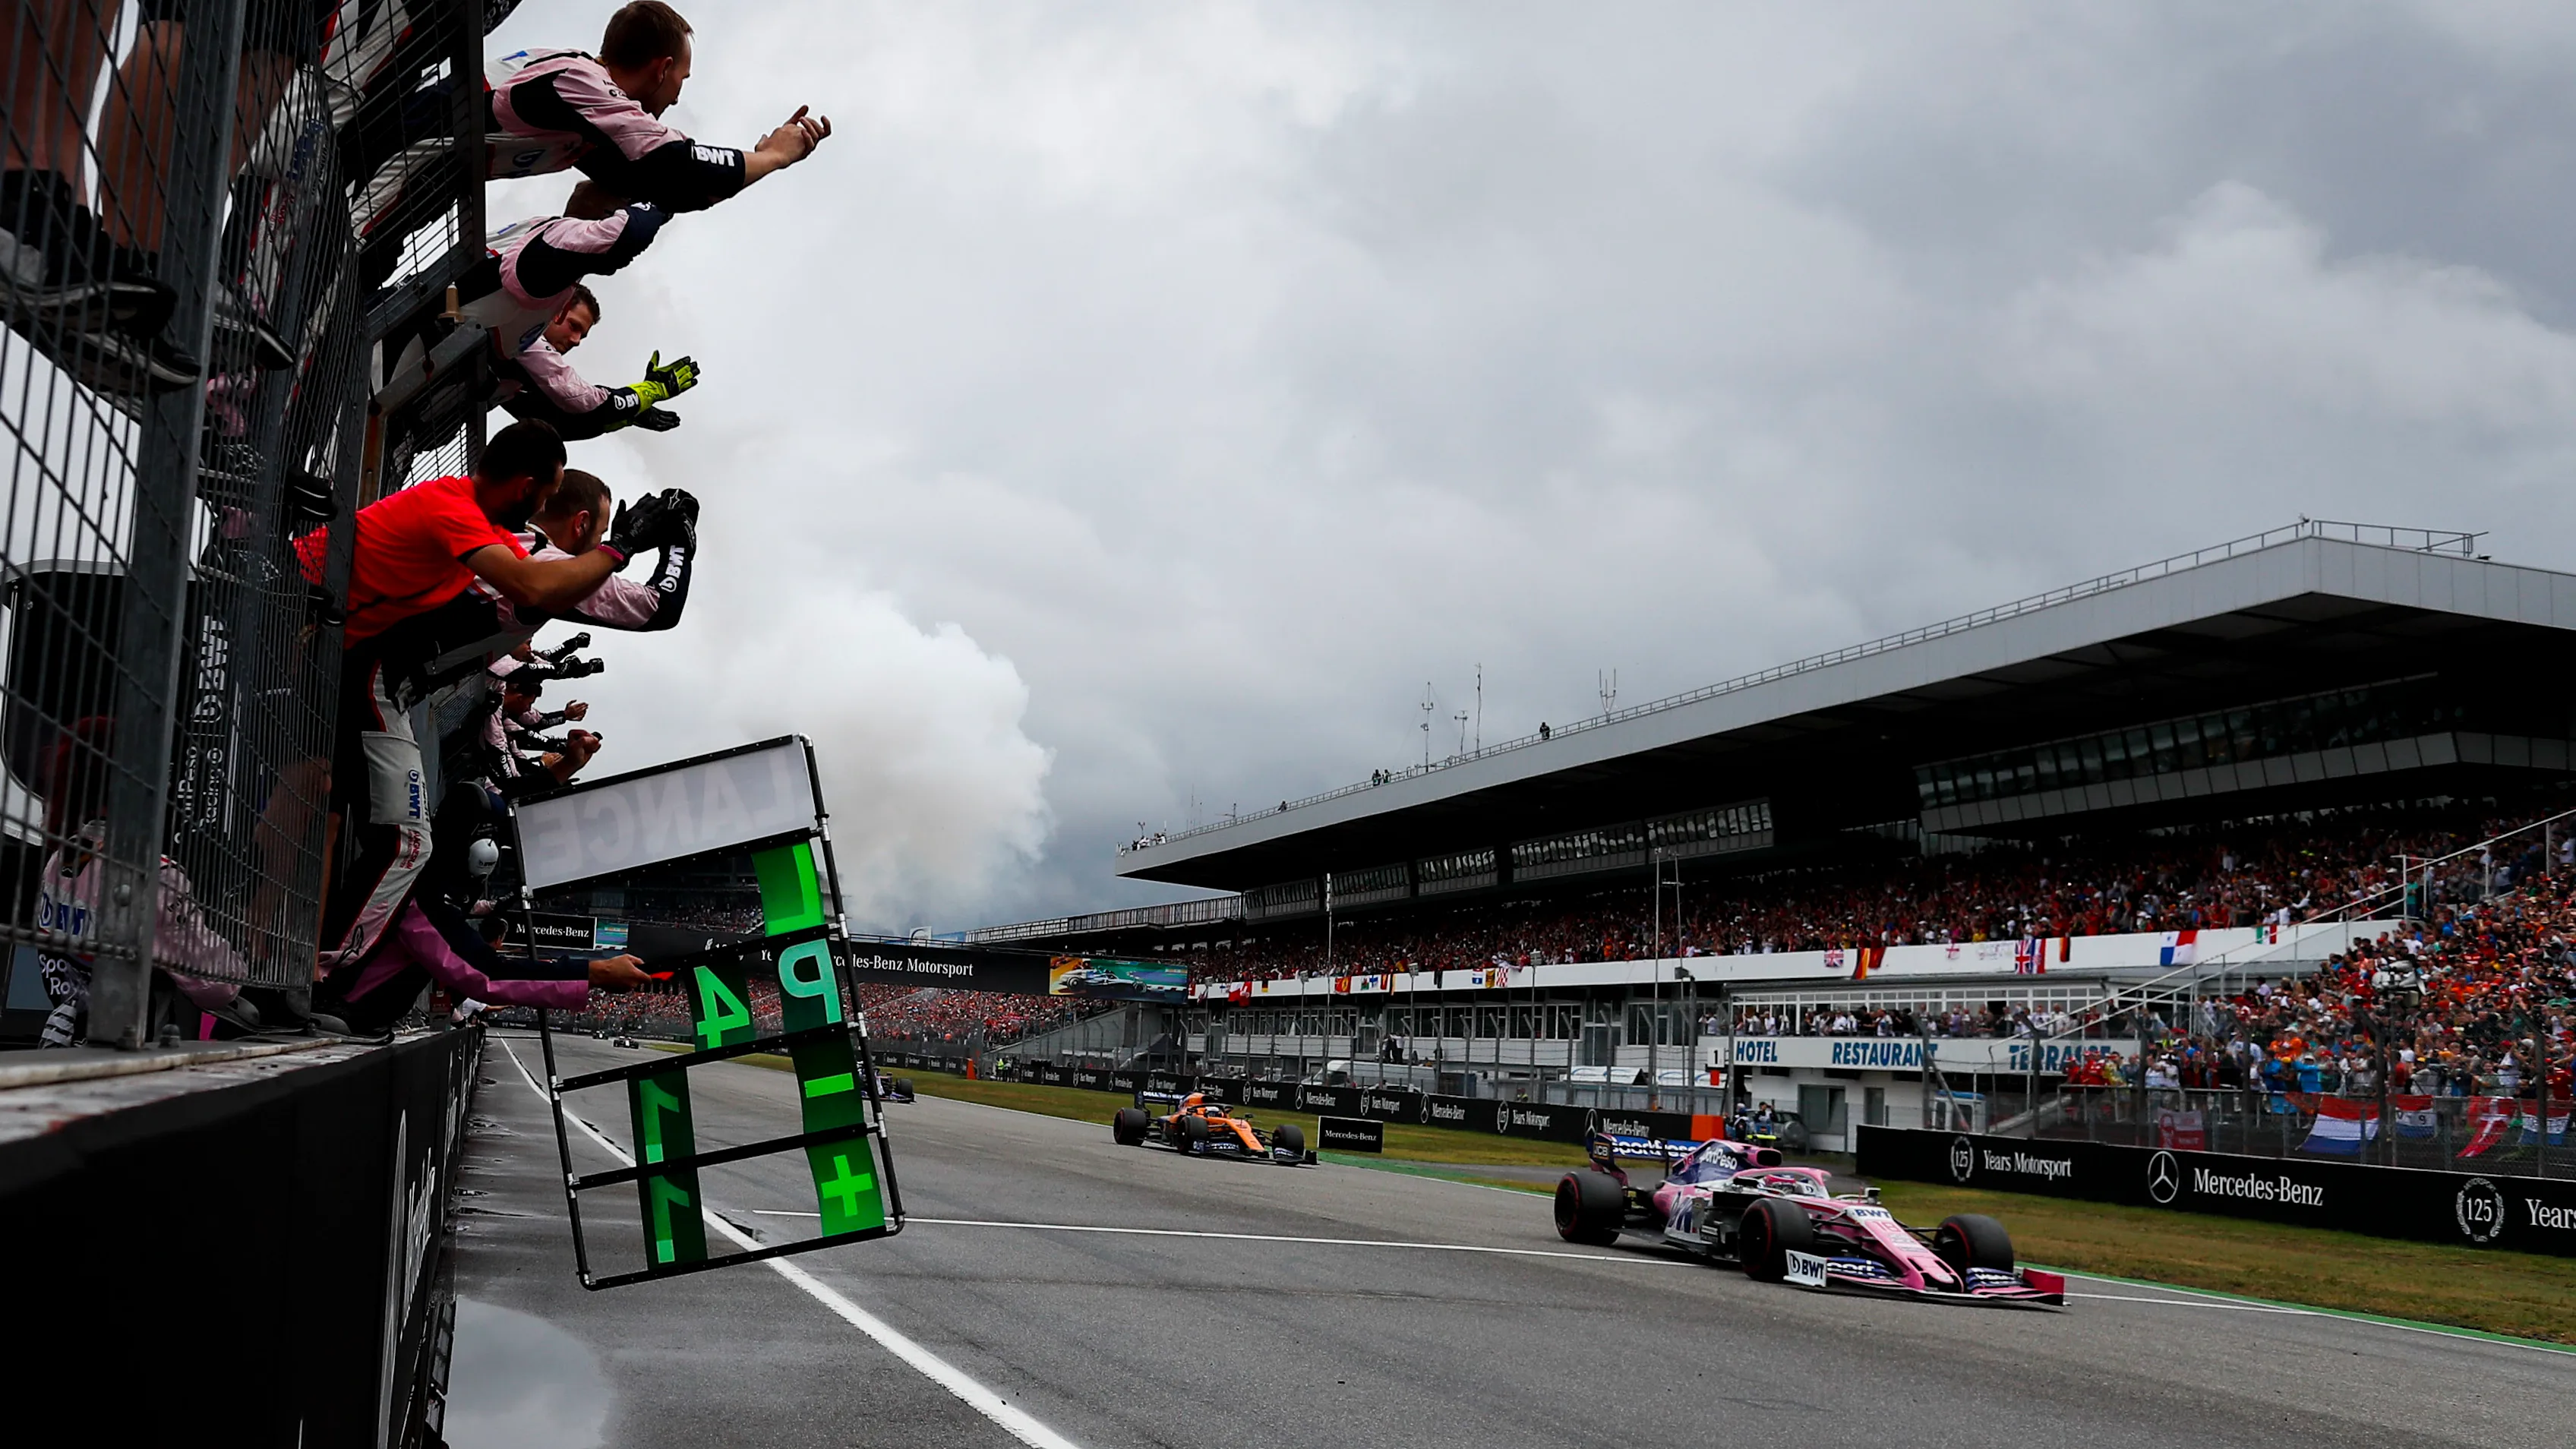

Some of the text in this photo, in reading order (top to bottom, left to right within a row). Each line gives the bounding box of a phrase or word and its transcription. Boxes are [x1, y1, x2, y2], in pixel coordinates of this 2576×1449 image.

[694, 146, 735, 167] BWT
[665, 545, 685, 579] BWT
[409, 784, 421, 819] BWT
[516, 923, 590, 939] Mrcedes-Benz
[907, 958, 974, 978] Motorsport
[1713, 1049, 1719, 1065] 1
[1735, 1040, 1778, 1062] HOTEL
[1832, 1042, 1939, 1068] RESTAURANT
[1306, 1091, 1336, 1106] Mercedes-Benz
[1381, 1096, 1400, 1114] Motorsport
[1432, 1103, 1466, 1120] Mercedes-Benz
[1525, 1110, 1551, 1130] Motorsport
[1324, 1129, 1377, 1141] Mercedes-Benz
[1602, 1118, 1650, 1138] Mercedes-Benz
[1955, 1149, 2072, 1181] 125 Years Motorsport
[2192, 1166, 2324, 1207] Mercedes-Benz
[1854, 1209, 1890, 1218] BWT
[2467, 1198, 2492, 1223] 125
[1801, 1259, 1824, 1280] BWT
